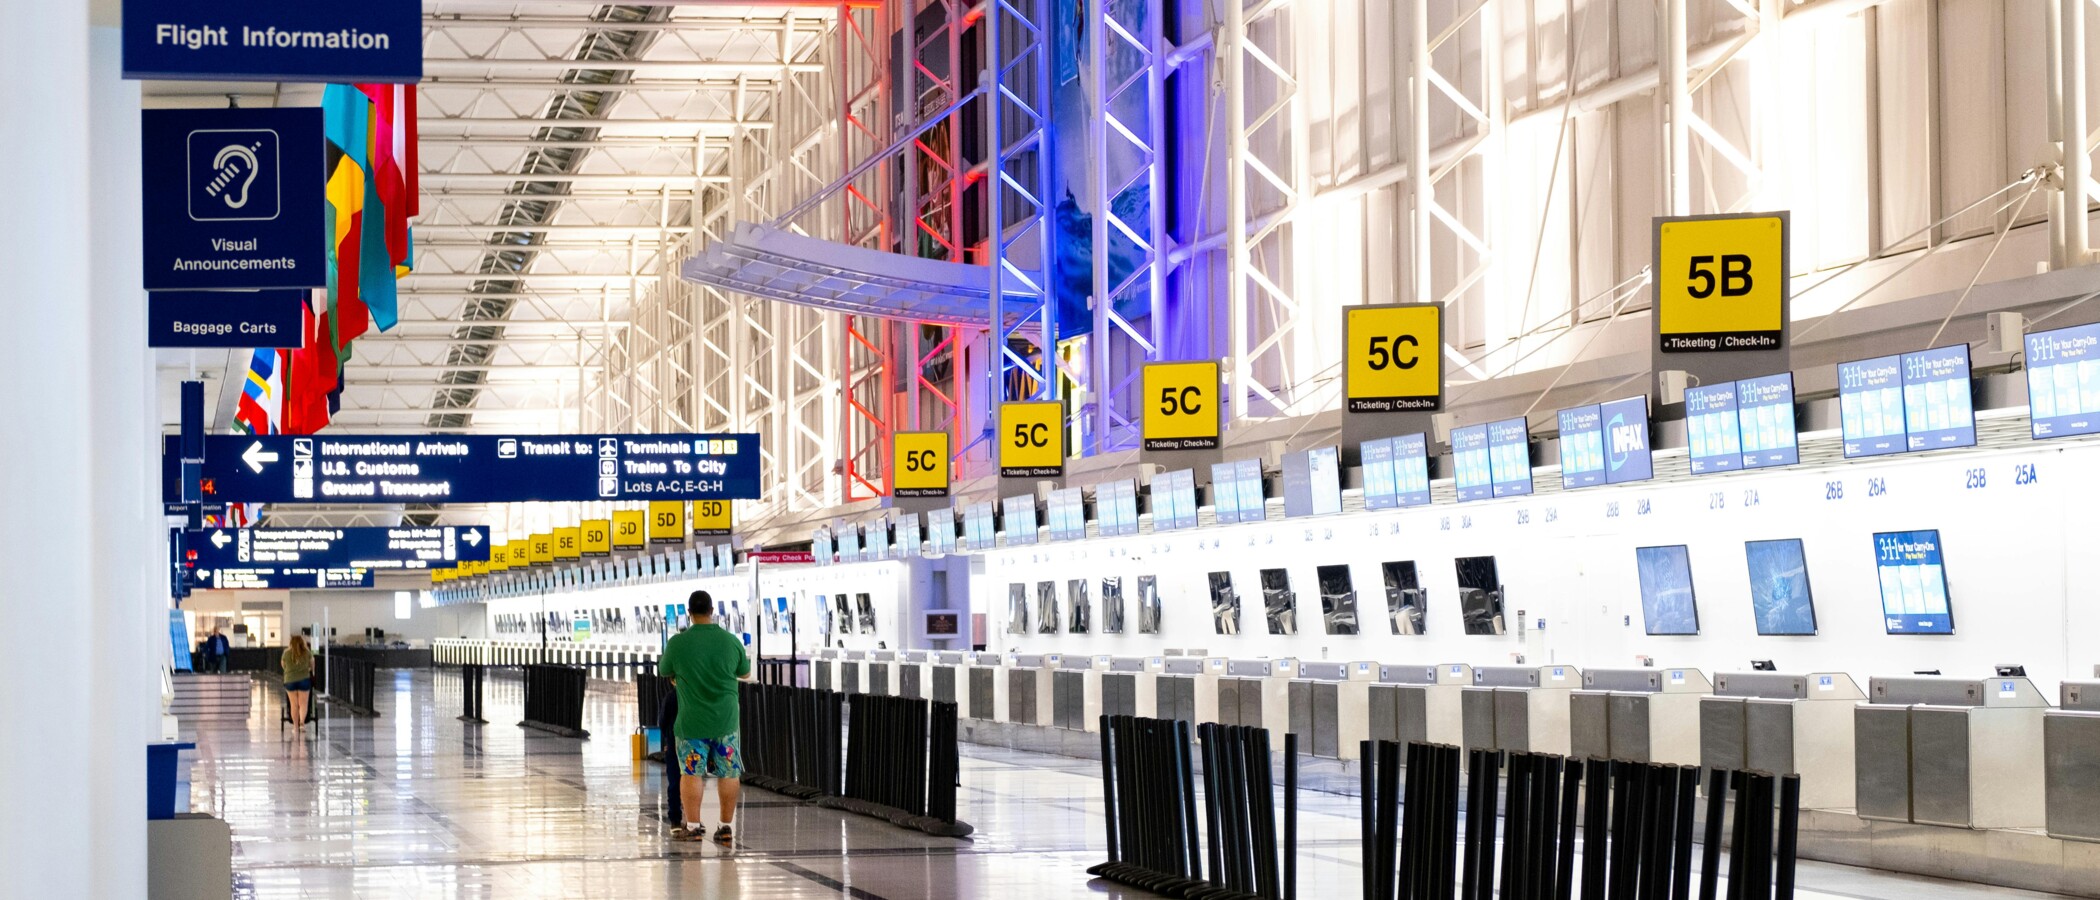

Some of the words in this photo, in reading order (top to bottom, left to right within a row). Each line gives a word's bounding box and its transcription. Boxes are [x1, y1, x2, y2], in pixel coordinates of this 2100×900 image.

[156, 24, 229, 50] Flight
[243, 25, 390, 50] Information
[211, 238, 258, 252] Visual
[173, 256, 296, 271] Announcements
[1687, 254, 1753, 299] 5B
[172, 320, 233, 335] Baggage
[239, 321, 277, 334] Carts
[1671, 337, 1716, 351] Ticketing
[1725, 336, 1770, 347] Check-In
[2031, 335, 2055, 362] 3-1-1
[2060, 339, 2072, 350] Your
[1367, 334, 1419, 371] 5C
[1906, 355, 1928, 380] 3-1-1
[1932, 359, 1942, 369] Your
[1843, 366, 1863, 389] 3-1-1
[1867, 369, 1877, 378] Your
[1160, 386, 1201, 416] 5C
[1740, 382, 1758, 404] 3-1-1
[1356, 400, 1390, 411] Ticketing
[1396, 399, 1431, 409] Check-In
[1689, 391, 1706, 412] 3-1-1
[1014, 422, 1049, 448] 5C
[1612, 423, 1644, 454] INFAX
[321, 441, 410, 456] International
[416, 441, 469, 456] Arrivals
[521, 441, 571, 455] Transit
[574, 442, 593, 455] to:
[623, 441, 691, 455] Terminals
[1150, 439, 1179, 449] Ticketing
[1183, 438, 1211, 447] Check-In
[623, 461, 667, 474] Trains
[673, 461, 691, 474] To
[697, 460, 727, 476] City
[906, 449, 936, 472] 5C
[321, 462, 351, 476] U.S.
[355, 462, 420, 476] Customs
[1006, 468, 1029, 477] Ticketing
[1032, 467, 1057, 475] Check-In
[2015, 463, 2037, 485] 25A
[1966, 467, 1987, 489] 25B
[321, 481, 375, 496] Ground
[380, 481, 450, 497] Transport
[624, 481, 653, 493] Lots
[656, 480, 723, 494] A-C,E-G-H
[1825, 480, 1844, 500] 26B
[1868, 477, 1887, 497] 26A
[1709, 491, 1725, 510] 27B
[1744, 489, 1760, 507] 27A
[168, 504, 188, 512] Airport
[702, 501, 722, 517] 5D
[1637, 498, 1652, 515] 28A
[657, 512, 676, 527] 5D
[587, 530, 603, 543] 5D
[620, 522, 637, 535] 5D
[535, 542, 548, 554] 5E
[559, 537, 574, 549] 5E
[1879, 537, 1901, 561] 3-1-1
[1904, 542, 1914, 552] Your
[494, 553, 506, 563] 5E
[513, 548, 526, 559] 5E
